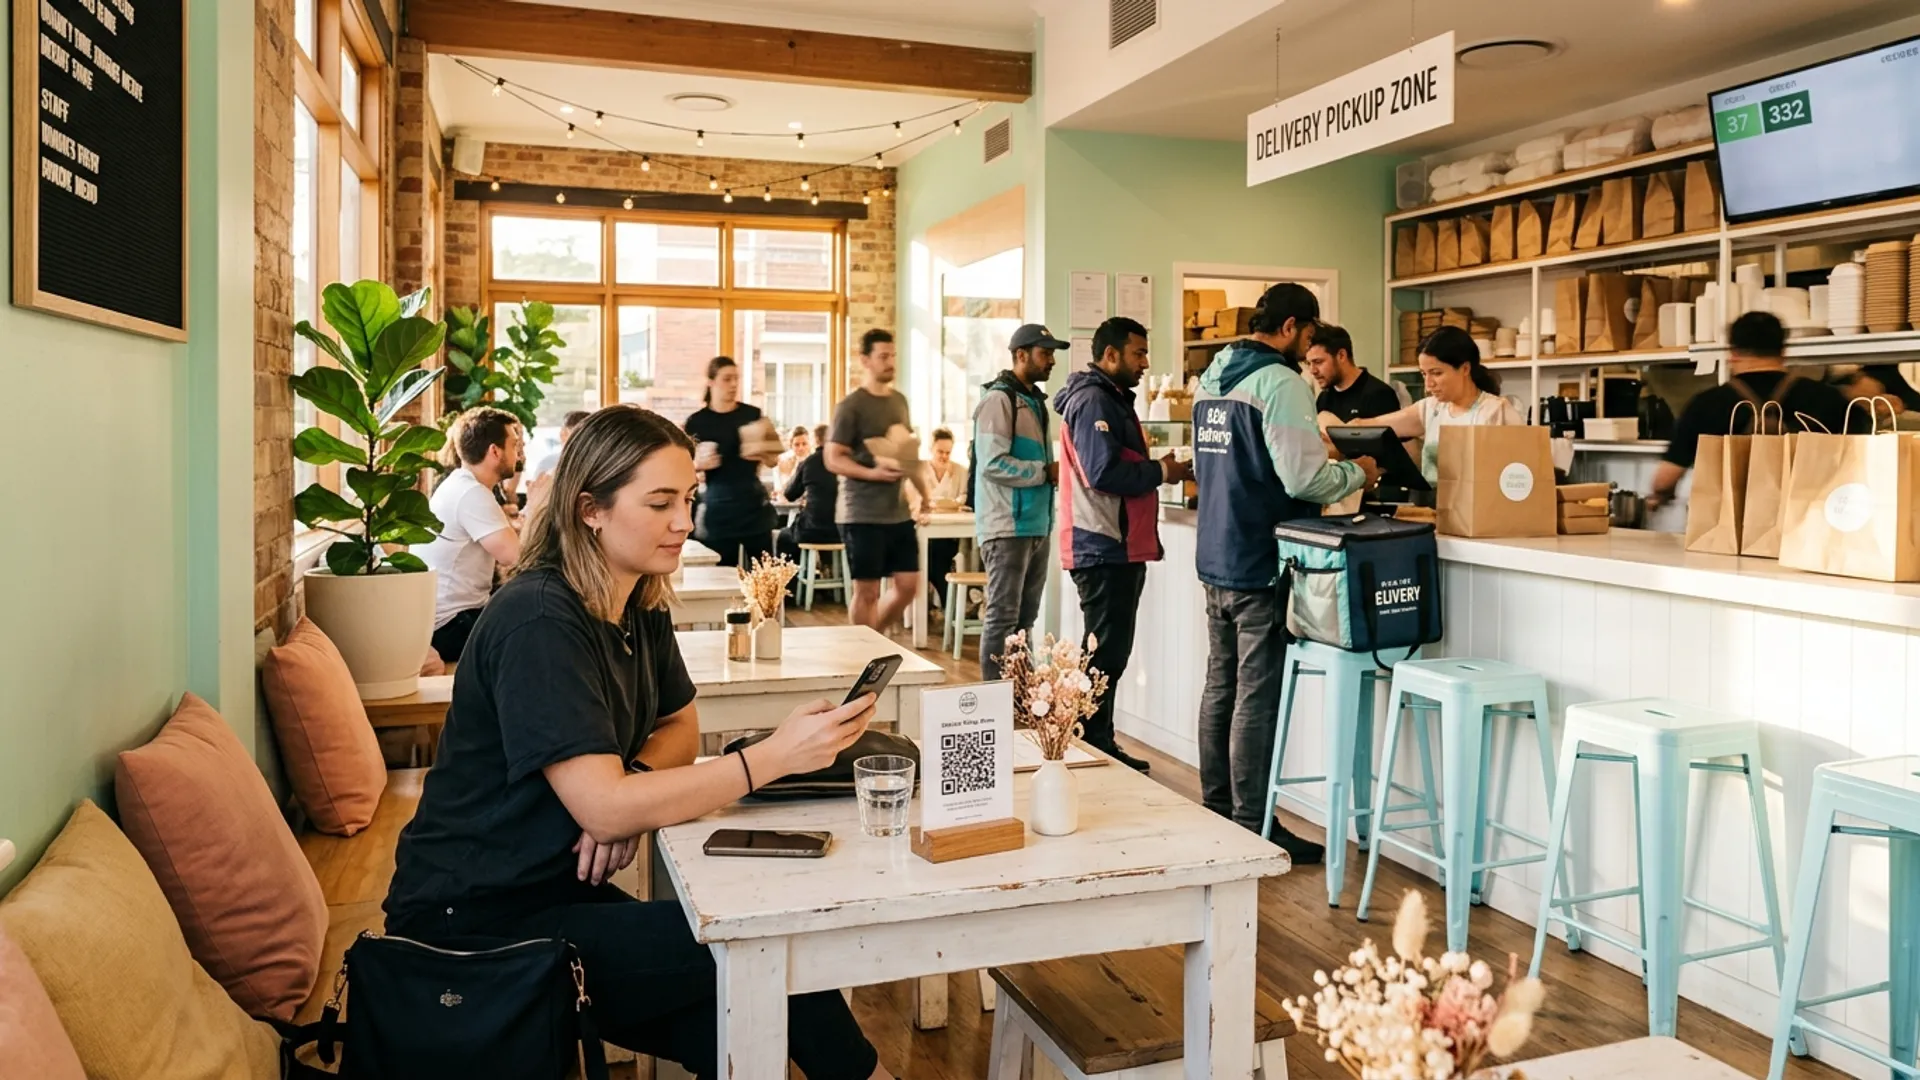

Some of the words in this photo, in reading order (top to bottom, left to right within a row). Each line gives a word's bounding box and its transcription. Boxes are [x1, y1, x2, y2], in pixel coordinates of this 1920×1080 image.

[1256, 110, 1322, 161] DELIVERY
[1326, 87, 1385, 137] PICKUP
[1390, 65, 1438, 115] ZONE
[1727, 113, 1748, 133] 37
[1768, 99, 1805, 124] 332
